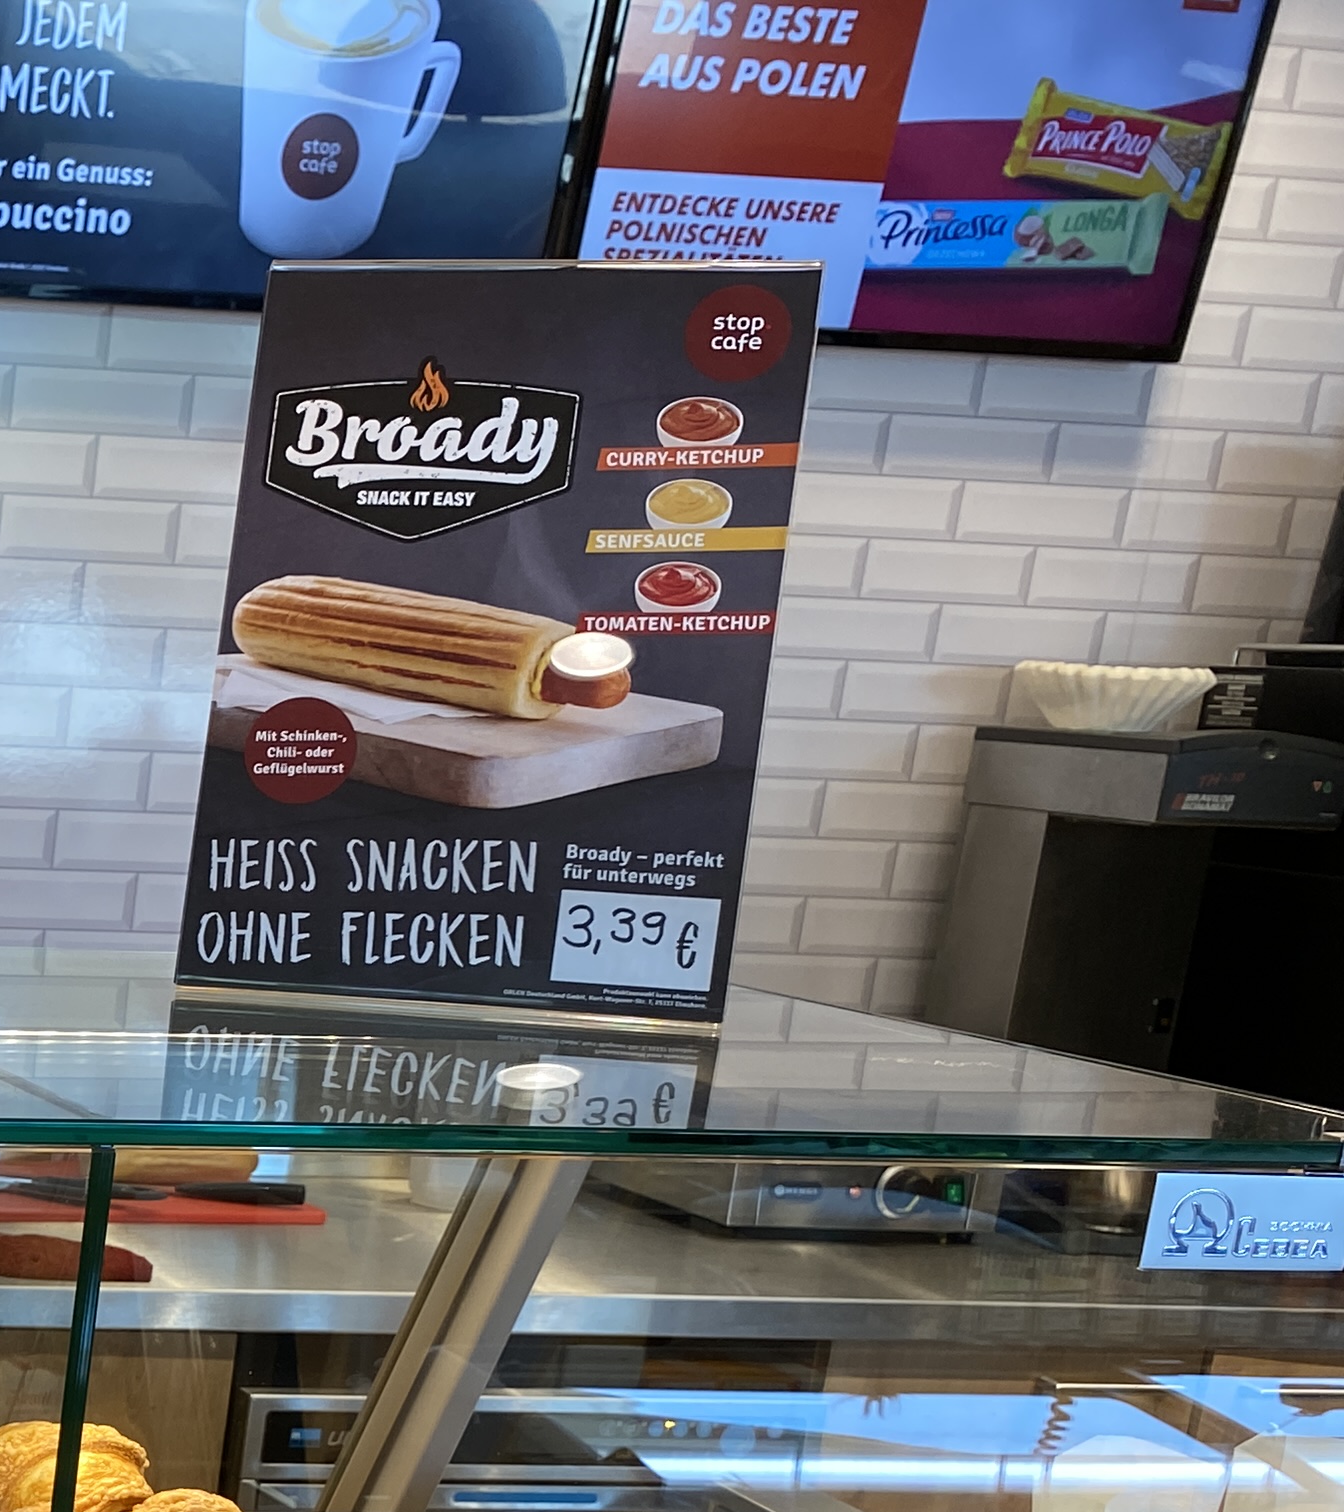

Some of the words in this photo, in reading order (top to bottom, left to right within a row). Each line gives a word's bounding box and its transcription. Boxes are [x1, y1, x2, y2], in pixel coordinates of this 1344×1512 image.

[16, 0, 127, 52] JEDEM
[652, 0, 737, 39] DAS
[748, 3, 861, 47] BESTE
[640, 54, 722, 93] AUS
[731, 60, 866, 101] POLEN
[301, 138, 341, 157] stop
[1037, 120, 1103, 154] PRINCE
[1101, 120, 1152, 157] POLO
[12, 156, 50, 181] ein
[57, 158, 154, 188] Genuss:
[299, 155, 339, 176] cafe
[610, 191, 740, 218] ENTDECKE
[745, 198, 841, 224] UNSERE
[1062, 204, 1129, 234] LONGA
[605, 219, 768, 248] POLNISCHEN
[878, 210, 1009, 249] Princessa
[713, 313, 765, 335] stop
[711, 331, 763, 353] cafe
[284, 397, 560, 487] Broady
[606, 447, 765, 469] CURRY-KETCHUP
[356, 489, 411, 507] SNACK
[413, 490, 430, 507] IT
[432, 490, 477, 508] EASY
[594, 531, 706, 551] SENFSAUCE
[584, 614, 771, 634] TOMATEN-KETCHUP
[255, 730, 277, 742] Mit
[280, 730, 347, 743] Schinken-,
[267, 746, 302, 758] Chili-
[305, 746, 335, 757] oder
[253, 762, 345, 777] Geflügelwurst
[209, 838, 316, 893] HEISS
[346, 839, 538, 894] SNACKEN
[566, 844, 632, 866] Broady
[652, 848, 725, 870] perfekt
[562, 862, 593, 883] für
[596, 867, 697, 889] unterwegs
[197, 911, 311, 964] OHNE
[340, 912, 524, 968] FLECKEN
